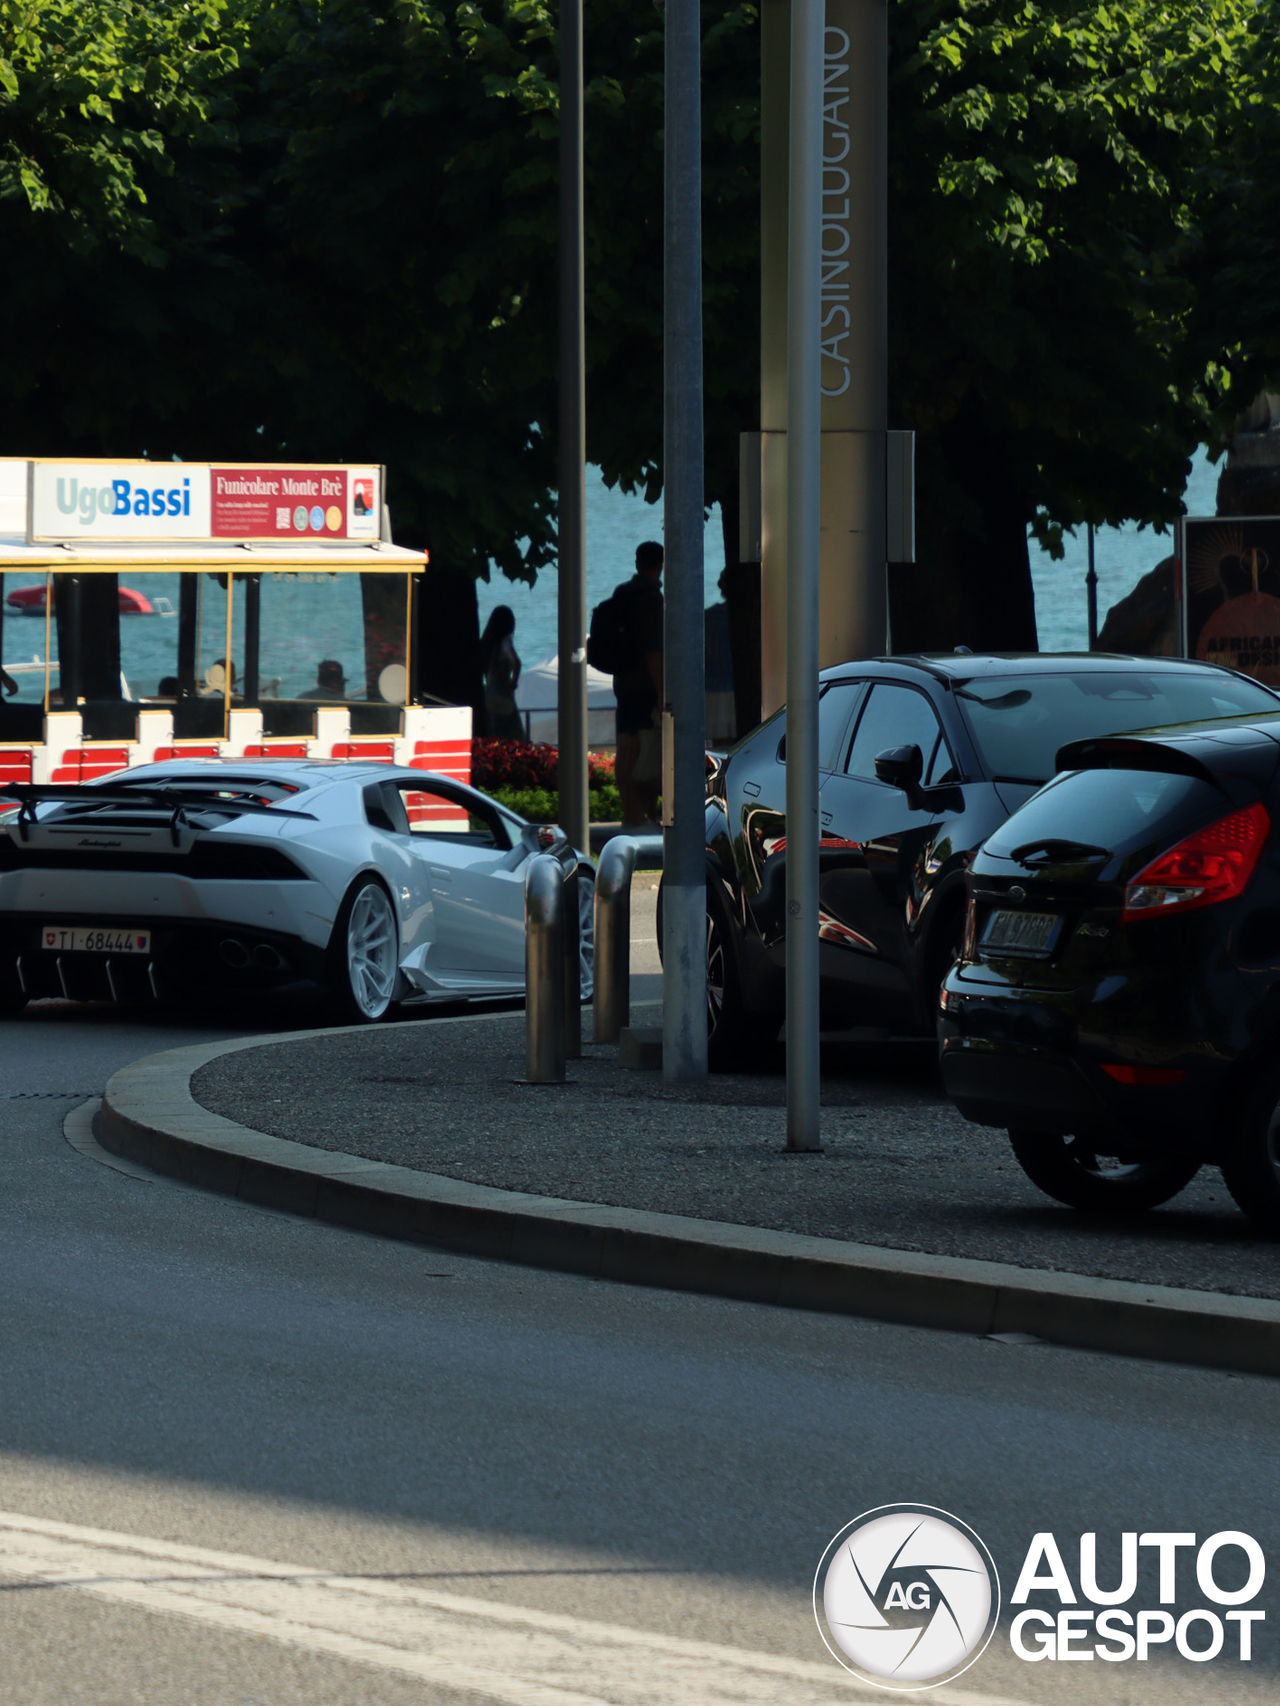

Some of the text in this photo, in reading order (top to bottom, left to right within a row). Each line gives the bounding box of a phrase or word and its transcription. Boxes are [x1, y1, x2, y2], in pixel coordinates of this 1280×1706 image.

[216, 476, 280, 496] Funicolare
[281, 478, 319, 496] Monte
[321, 476, 342, 496] Brè
[1238, 652, 1280, 667] DESI
